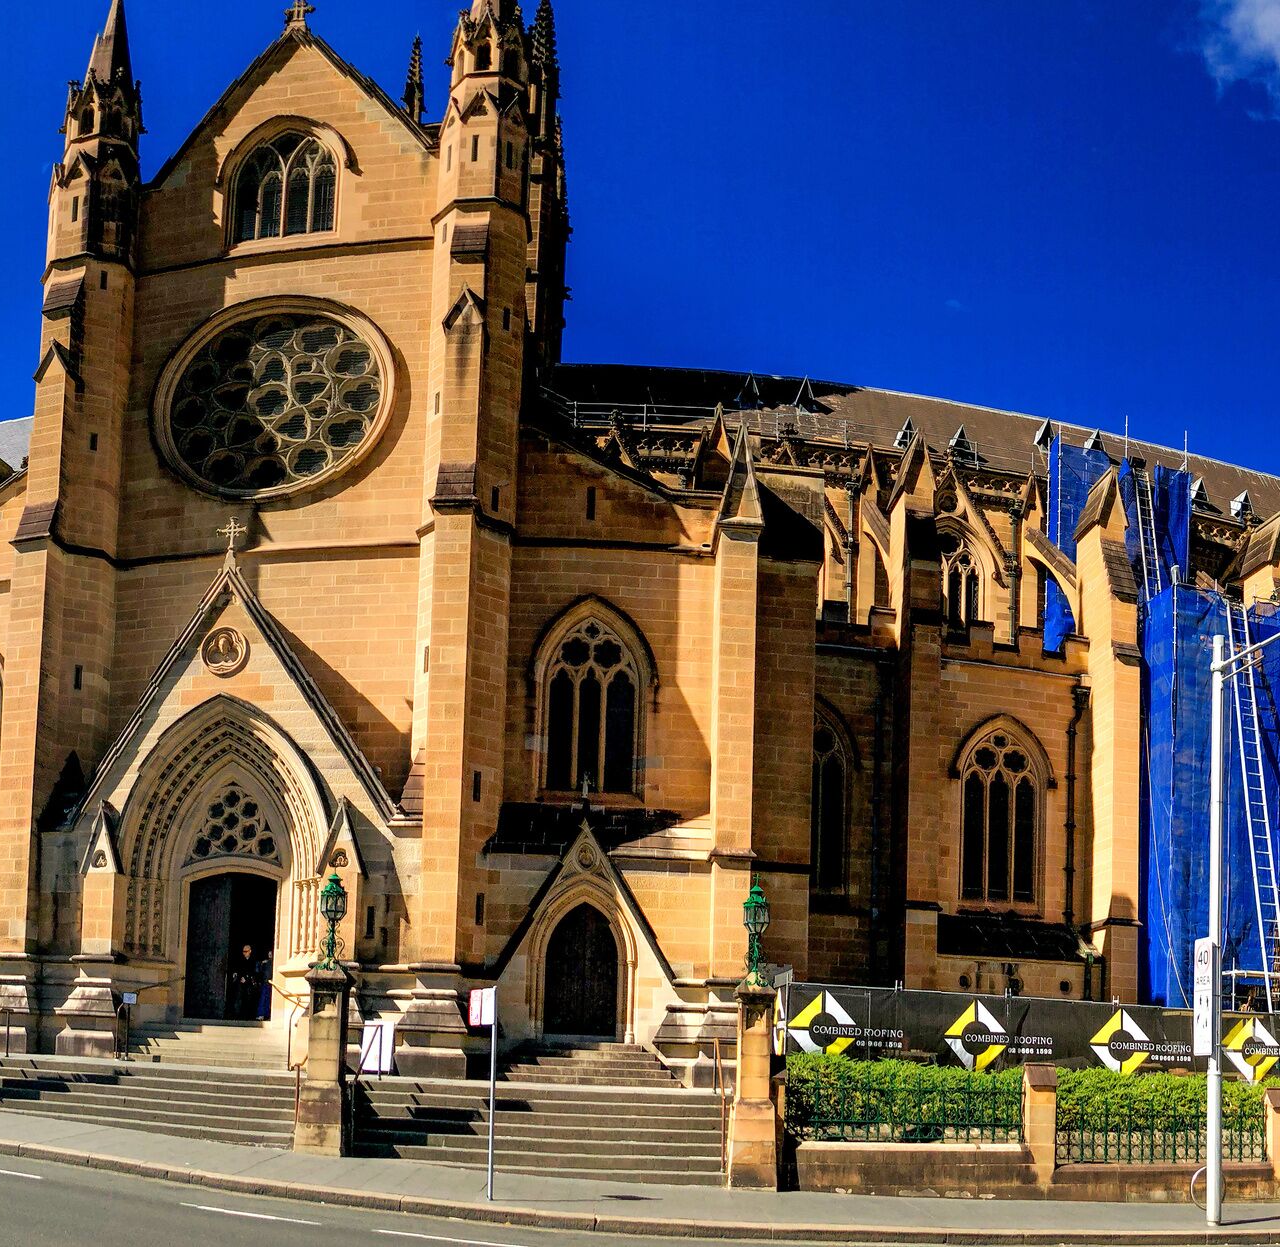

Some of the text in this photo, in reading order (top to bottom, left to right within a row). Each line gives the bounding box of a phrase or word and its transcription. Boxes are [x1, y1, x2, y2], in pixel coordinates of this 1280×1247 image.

[1198, 950, 1208, 965] 40
[1196, 975, 1210, 985] AREA
[812, 1025, 861, 1036] COMBINED
[965, 1033, 1053, 1045] COMBINED ROOFING
[1110, 1041, 1191, 1053] COMBINED ROOFING
